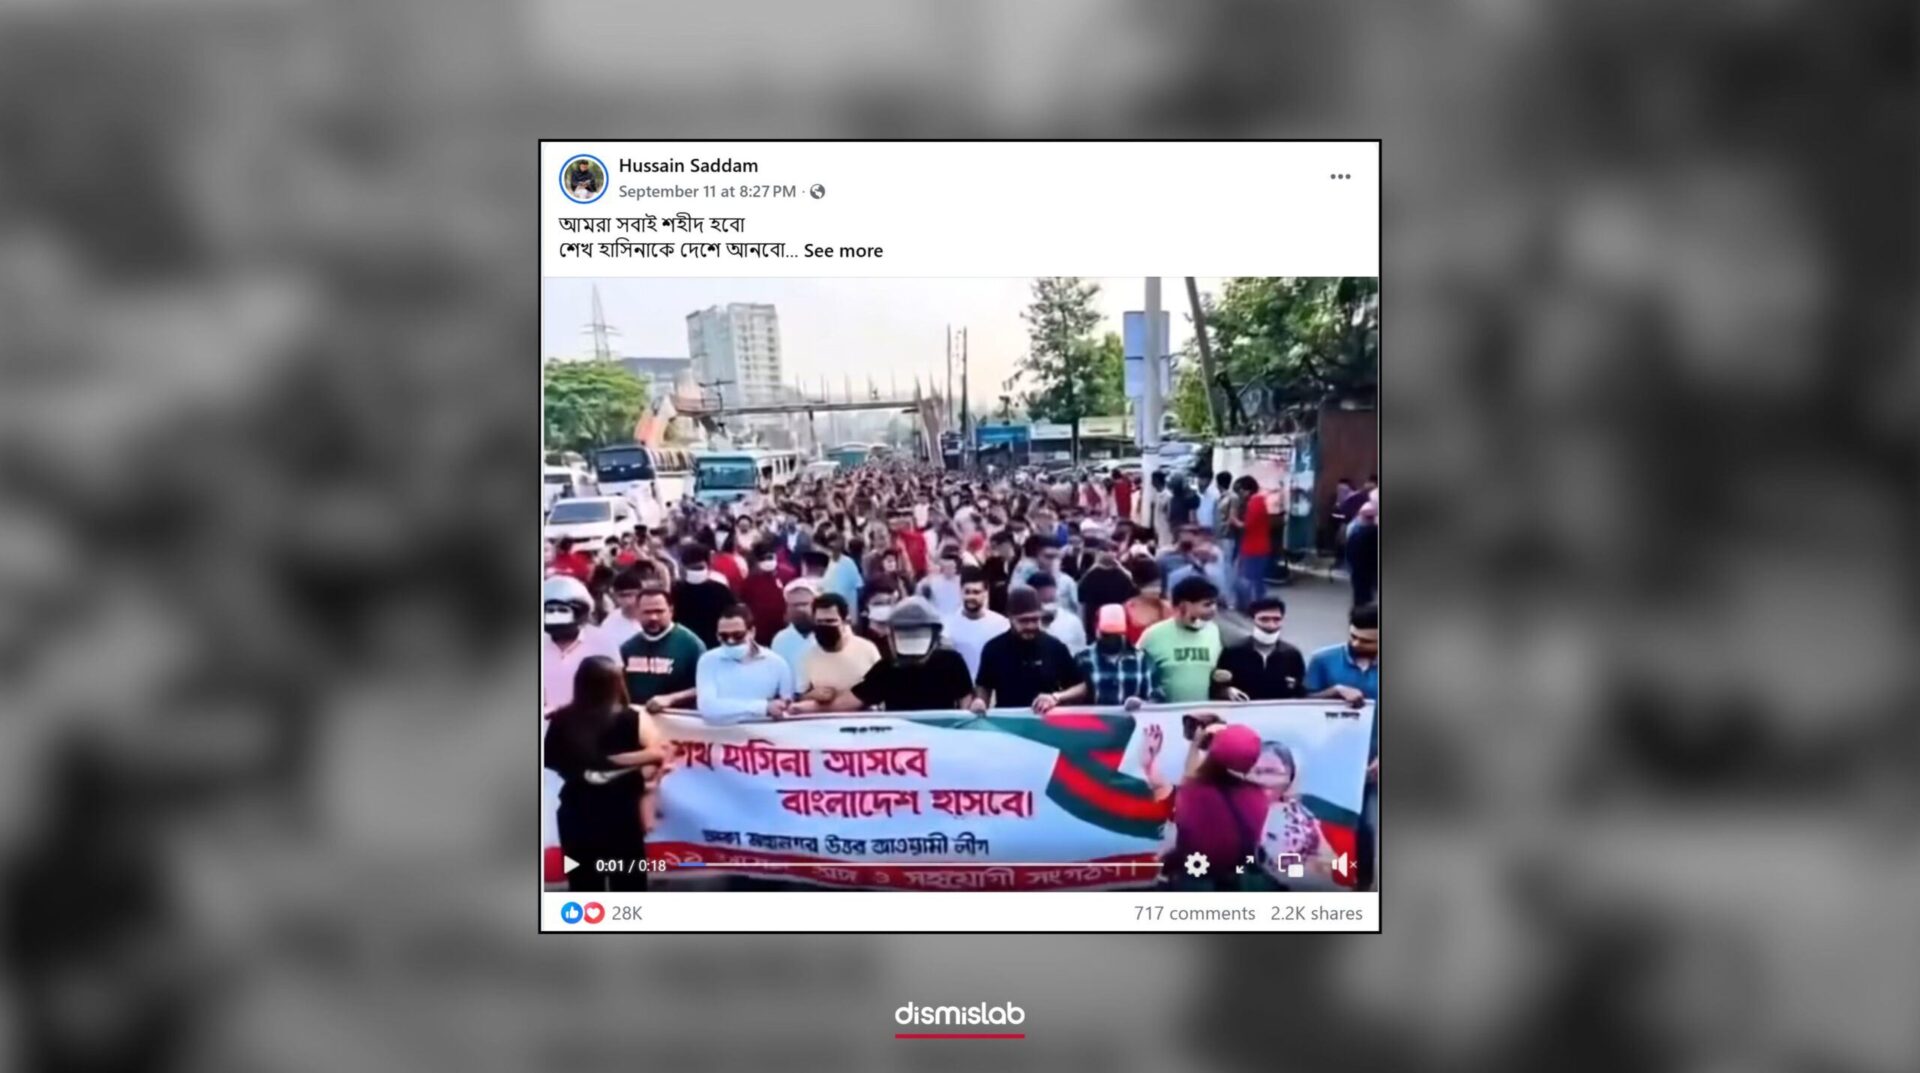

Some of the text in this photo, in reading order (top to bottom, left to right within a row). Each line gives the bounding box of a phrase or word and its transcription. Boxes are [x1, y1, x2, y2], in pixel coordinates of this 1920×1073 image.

[721, 739, 812, 778] হাসিনা
[820, 747, 928, 778] আসবে
[776, 789, 1032, 818] বাংলাদেশ হাসবে।
